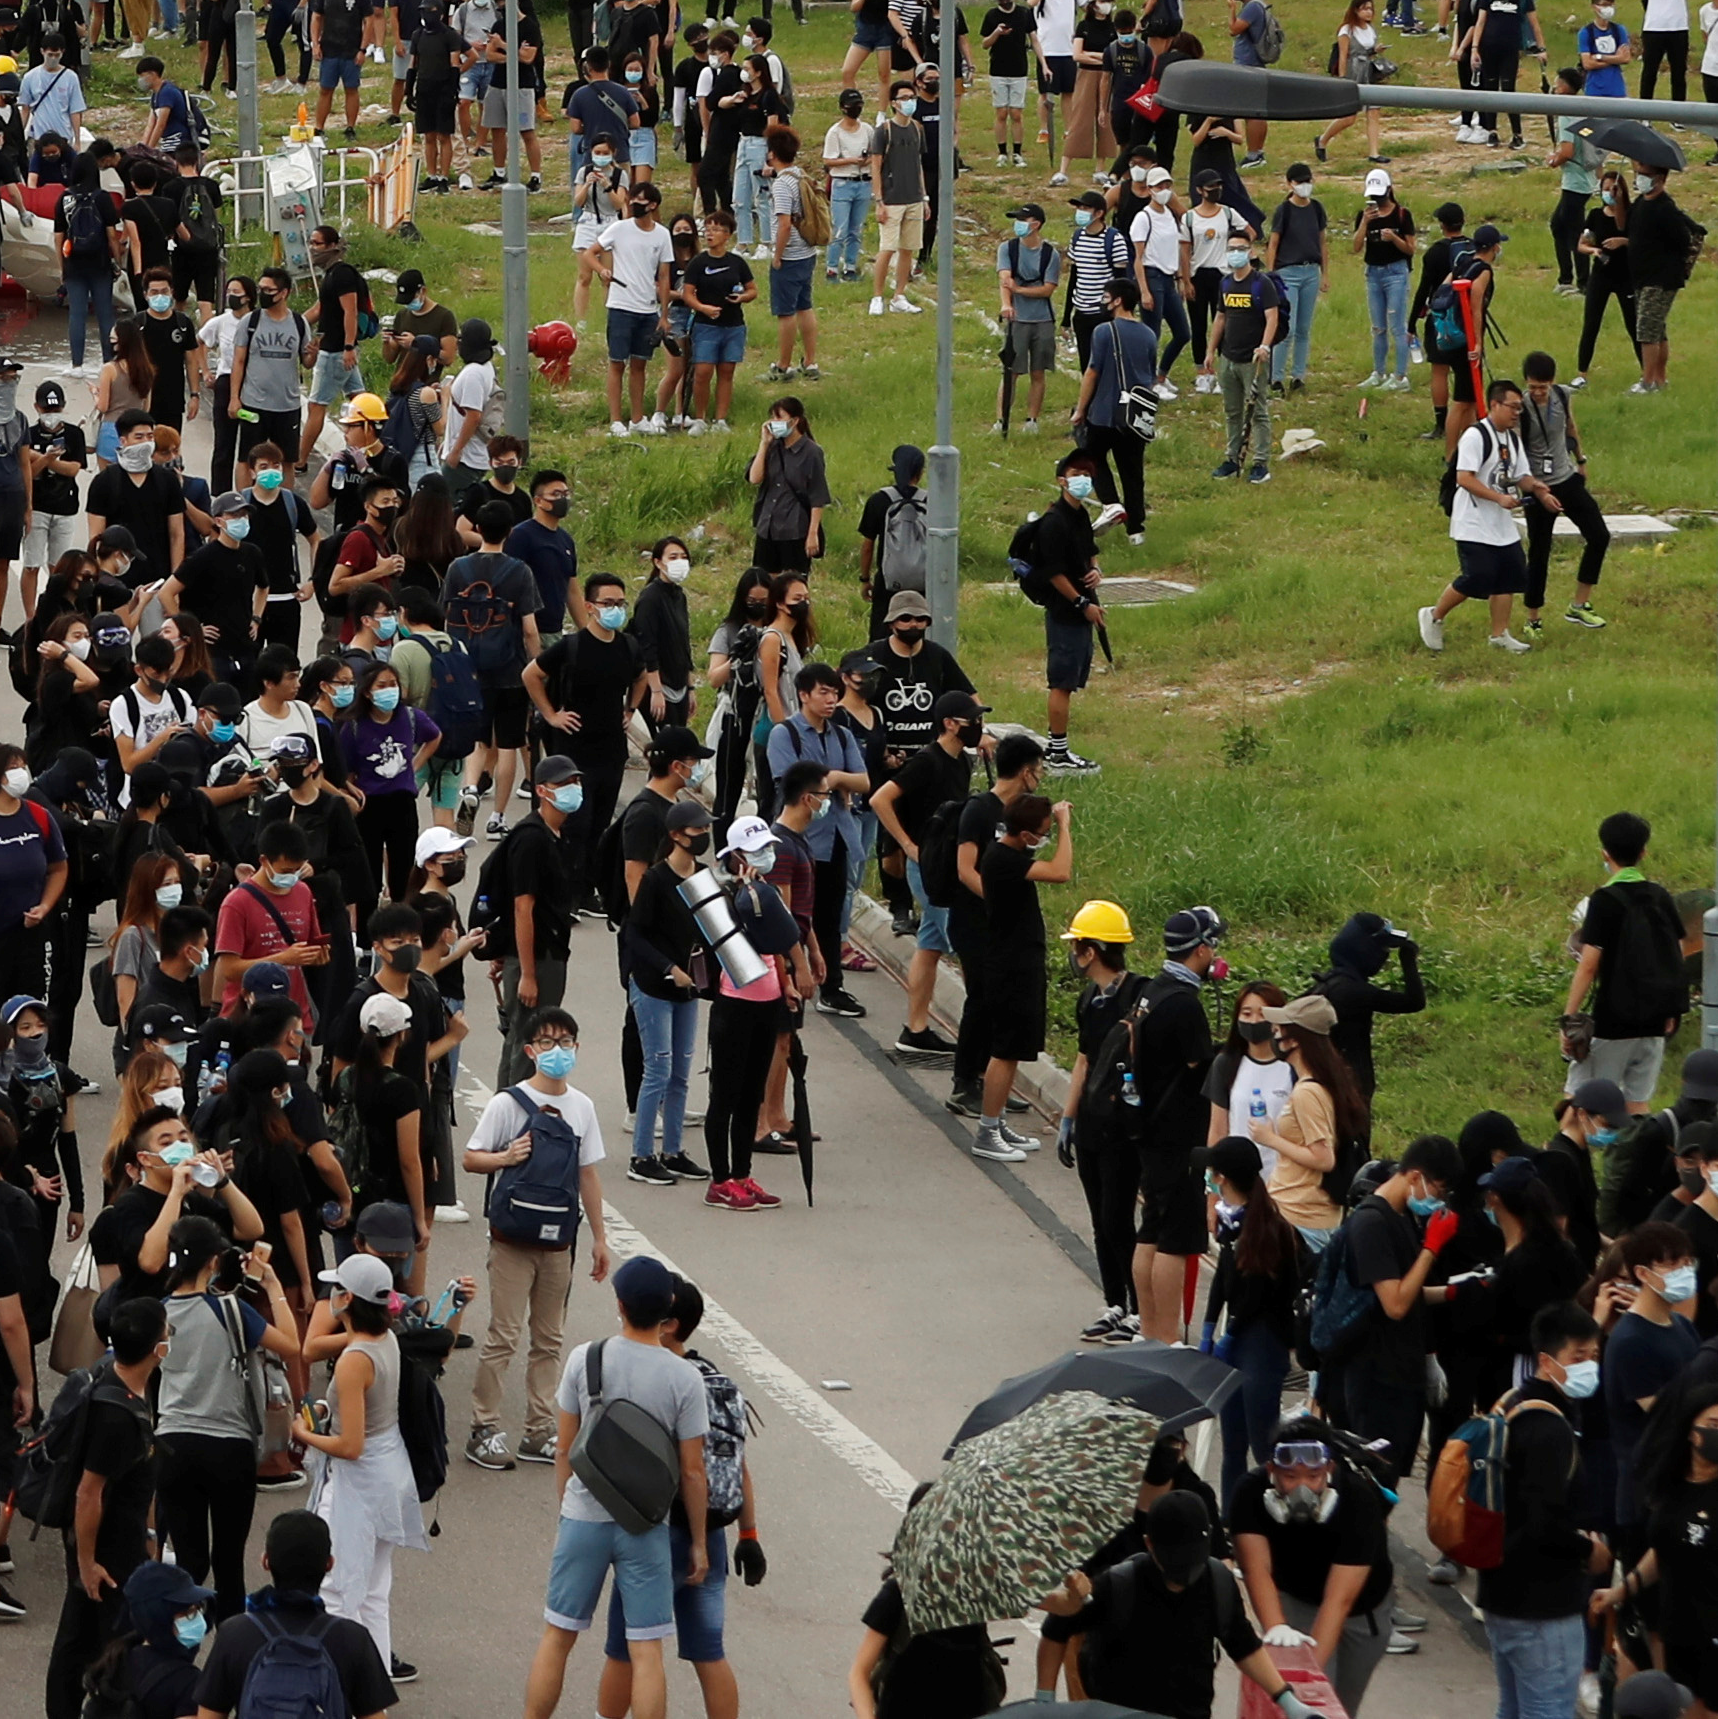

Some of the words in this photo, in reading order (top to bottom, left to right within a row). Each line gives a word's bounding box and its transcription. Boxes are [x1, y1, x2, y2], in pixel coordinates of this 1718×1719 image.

[1223, 293, 1252, 308] VANS
[256, 332, 297, 350] NIKE
[894, 721, 934, 732] GIANT
[745, 823, 768, 838] FILA
